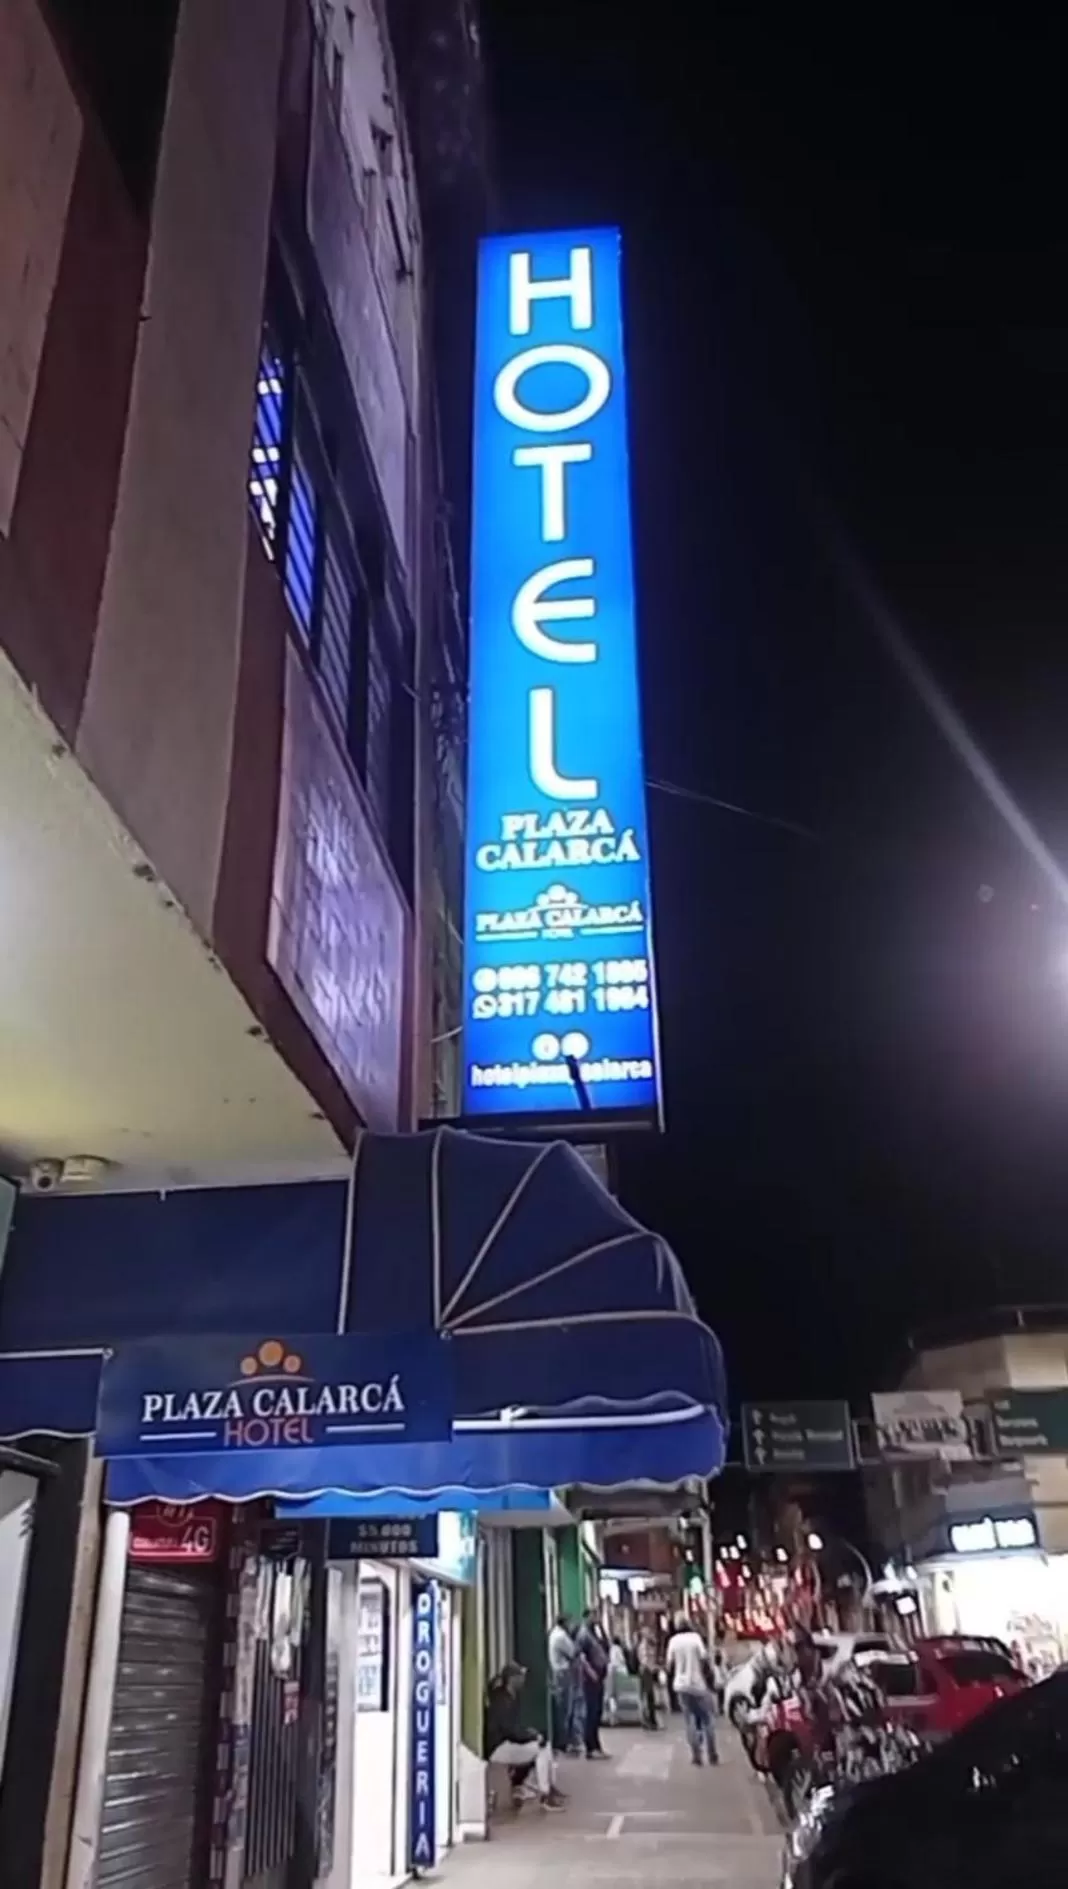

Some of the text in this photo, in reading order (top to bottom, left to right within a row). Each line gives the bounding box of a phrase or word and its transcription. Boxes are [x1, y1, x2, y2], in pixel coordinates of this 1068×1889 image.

[494, 247, 611, 801] HOTEL
[502, 808, 616, 841] PLAZA
[475, 829, 641, 872] CALARCÁ
[142, 1374, 404, 1422] PLAZA CALARCÁ
[224, 1418, 314, 1446] HOTEL
[182, 1515, 209, 1552] 4G
